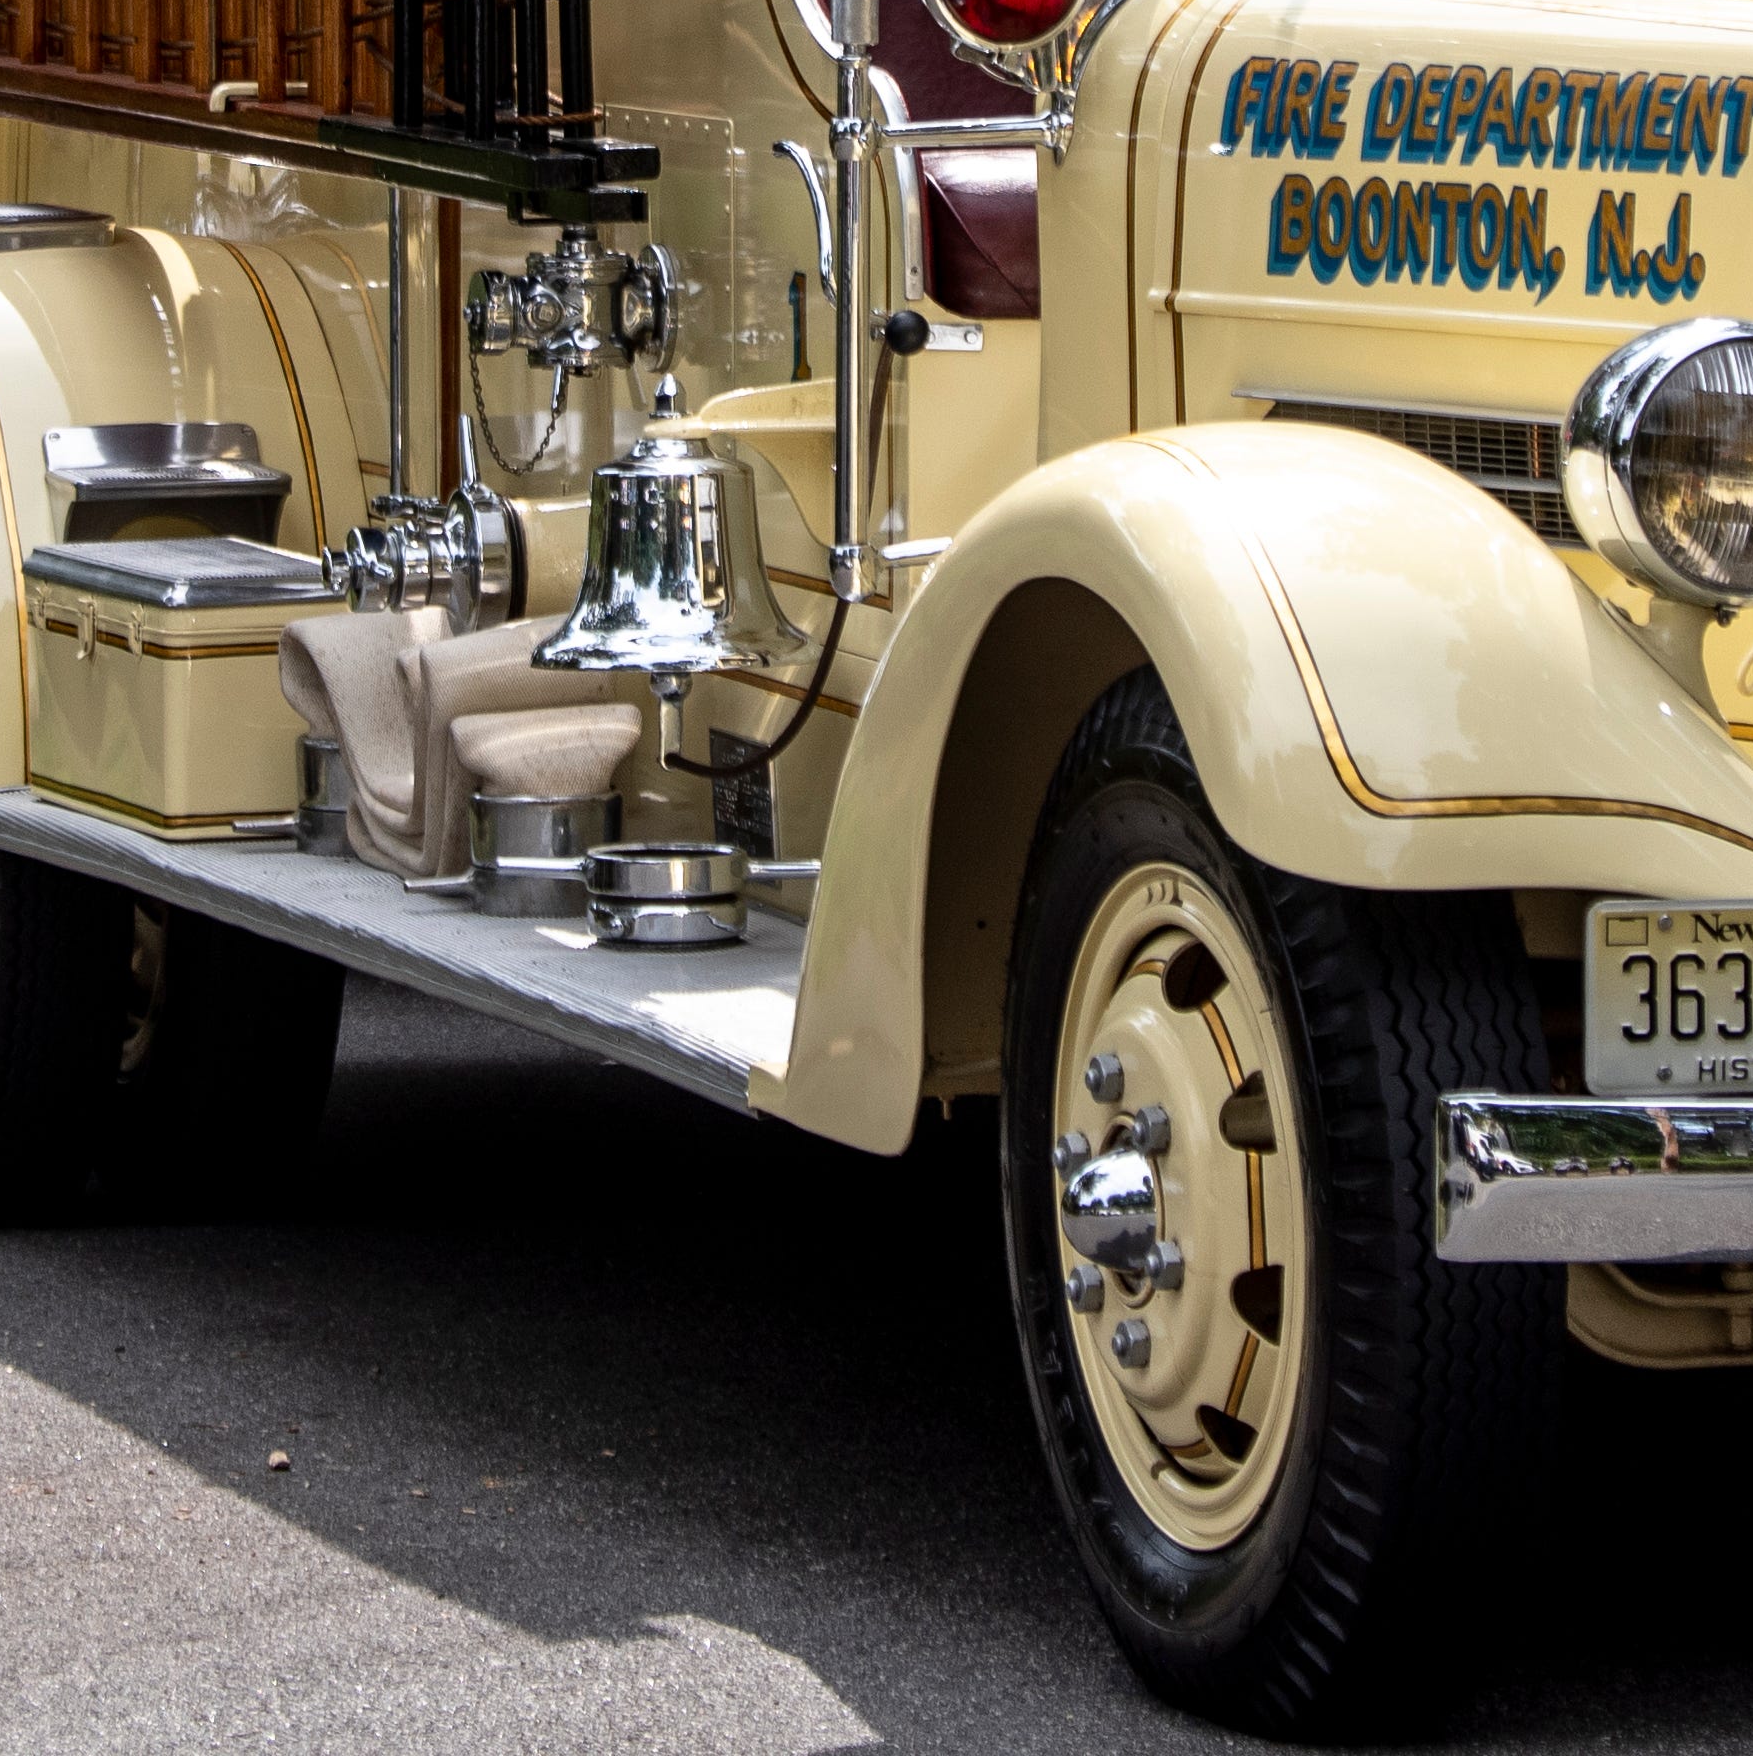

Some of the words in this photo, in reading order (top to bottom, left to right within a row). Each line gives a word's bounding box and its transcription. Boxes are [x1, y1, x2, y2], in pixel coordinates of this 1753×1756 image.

[1221, 55, 1359, 160] FIRE
[1267, 173, 1566, 306] BOONTON,
[1585, 189, 1706, 305] N.J.
